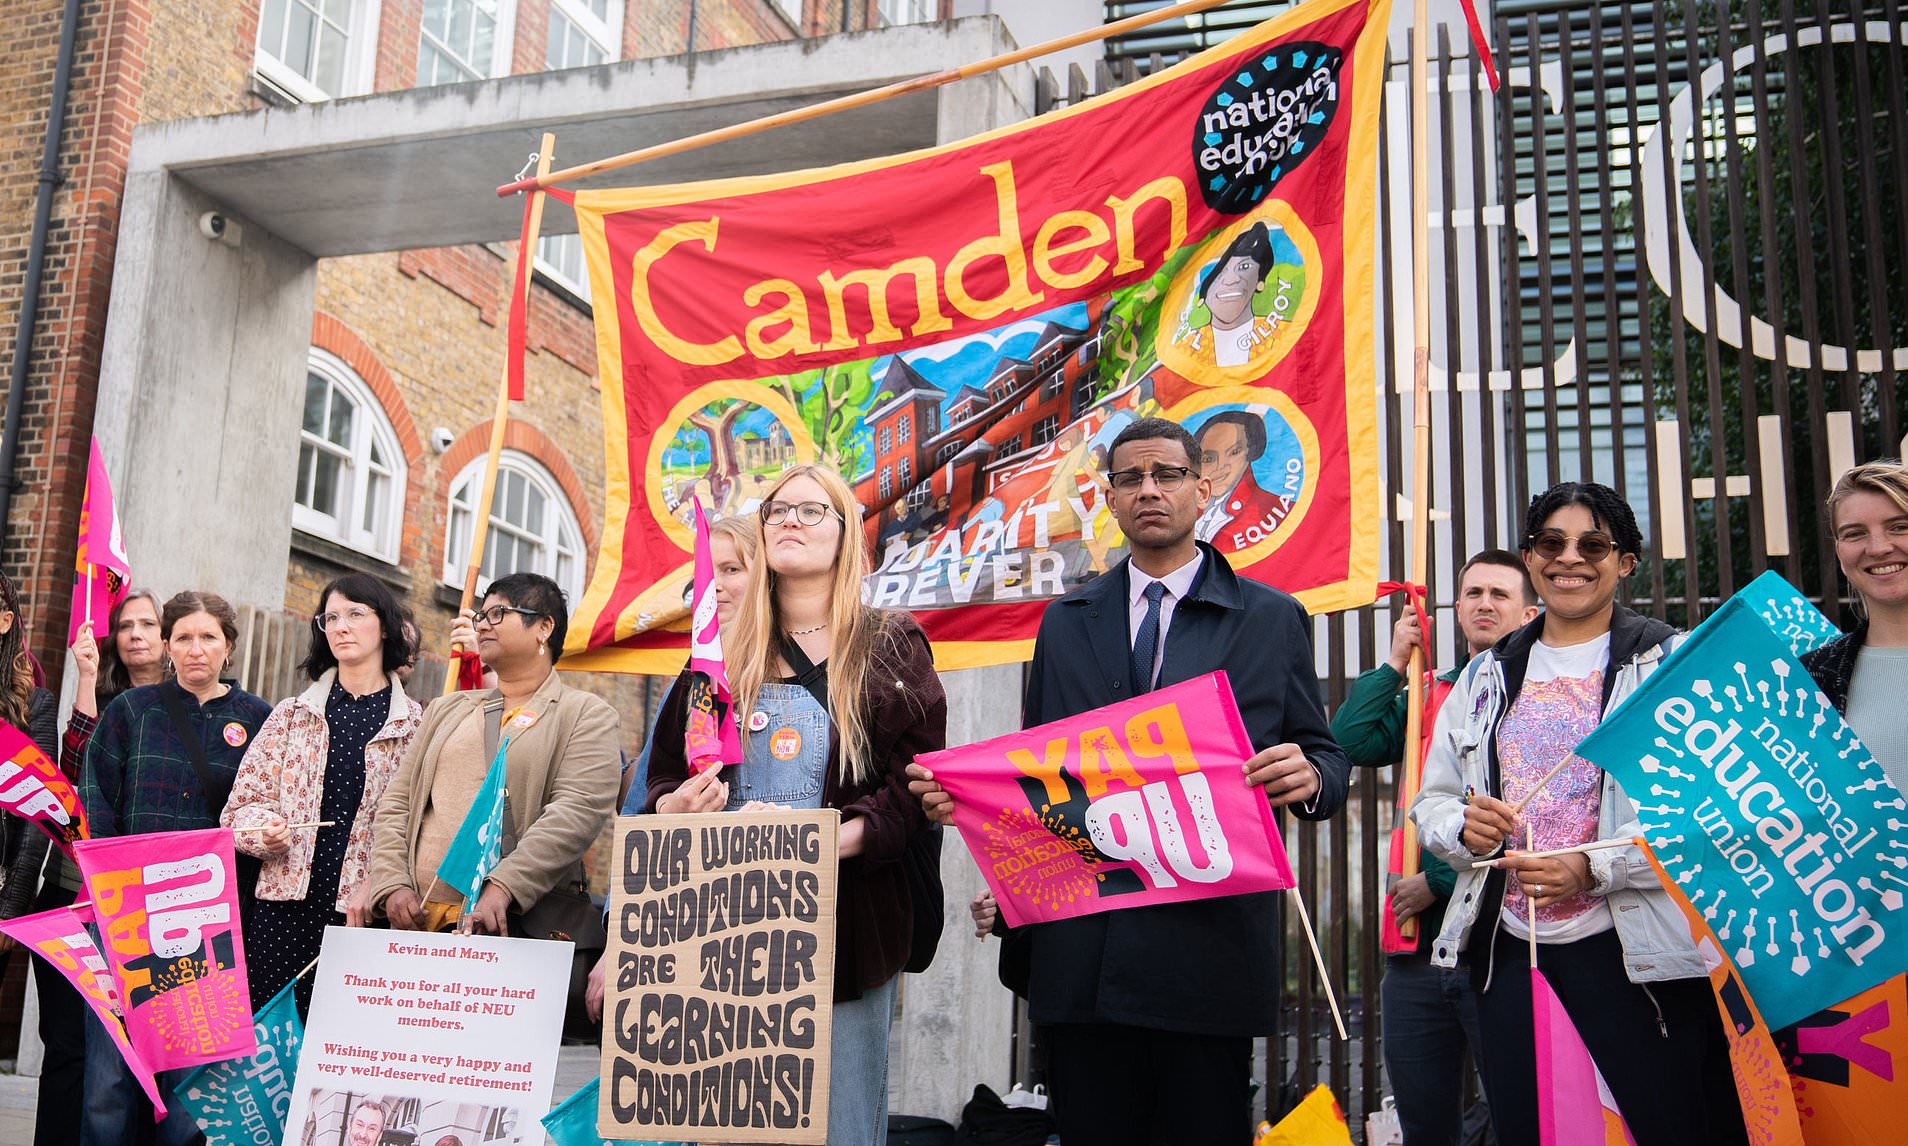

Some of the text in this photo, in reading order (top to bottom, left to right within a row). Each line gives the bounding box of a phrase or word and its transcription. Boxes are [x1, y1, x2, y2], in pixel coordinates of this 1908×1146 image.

[1203, 57, 1340, 133] nationa
[632, 160, 1188, 366] Camden
[1237, 279, 1292, 351] GILROY
[1233, 458, 1302, 550] EQUIANO
[866, 550, 1066, 610] REVER
[1750, 716, 1878, 859] national
[623, 823, 820, 895] OUR WORKING
[1654, 696, 1886, 967] education
[1694, 795, 1775, 899] union
[620, 869, 819, 948] CONDITIONS
[344, 974, 535, 1000] Thank you for all your hard
[388, 942, 499, 962] Kevin and Mary,
[700, 930, 818, 997] THEIR
[357, 994, 515, 1016] work on behalf of NEU
[398, 1015, 465, 1031] members.
[615, 994, 816, 1066] LEARNING
[318, 1062, 533, 1092] very well-deserved retirement!
[324, 1043, 531, 1074] Wishing you a very happy and
[611, 1054, 815, 1129] CONDITIONS!
